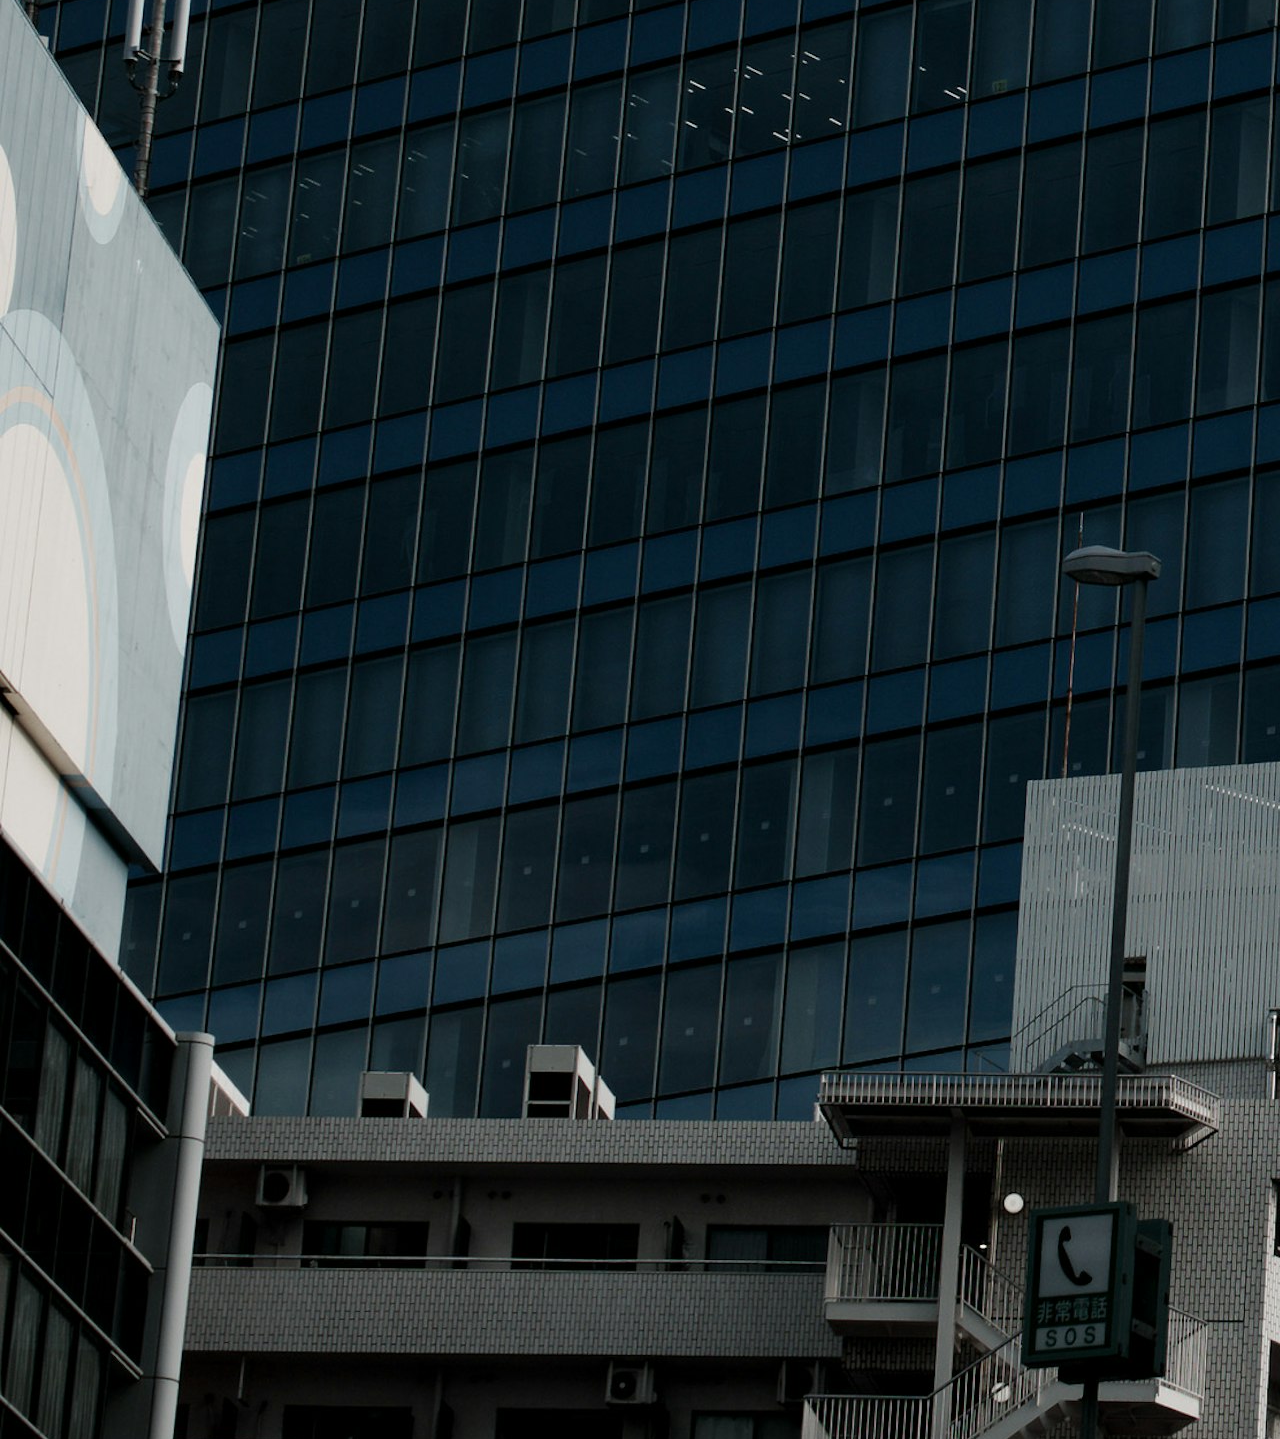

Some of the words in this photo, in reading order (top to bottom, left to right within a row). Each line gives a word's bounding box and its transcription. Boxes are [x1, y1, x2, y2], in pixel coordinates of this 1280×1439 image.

[1036, 1296, 1108, 1323] 非常電話
[1046, 1326, 1095, 1347] SOS
